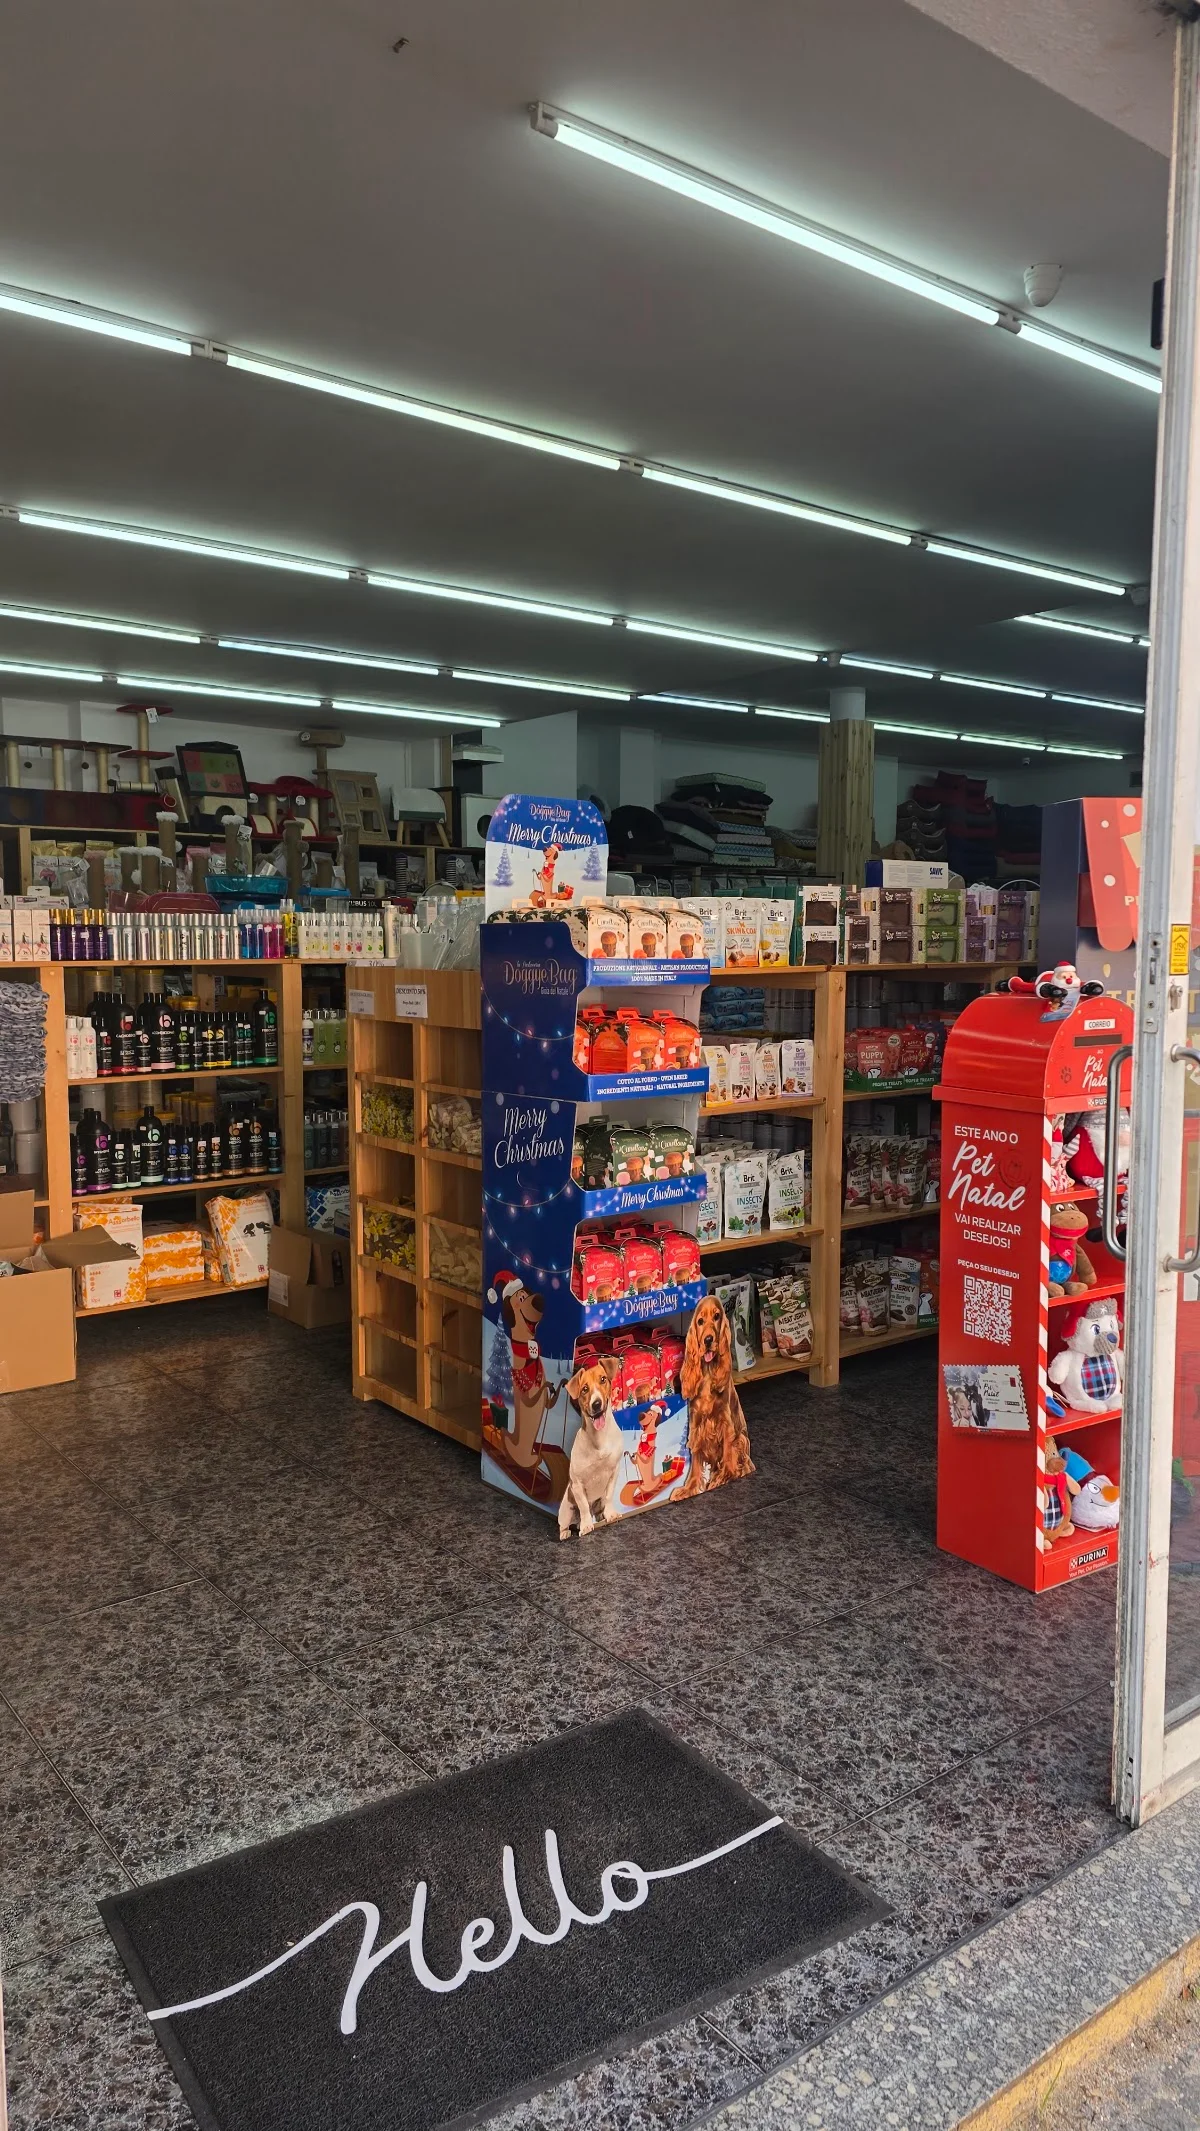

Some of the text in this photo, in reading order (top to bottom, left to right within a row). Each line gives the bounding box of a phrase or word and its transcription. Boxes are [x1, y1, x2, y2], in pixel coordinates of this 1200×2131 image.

[508, 822, 591, 848] Merry Christmas
[504, 958, 578, 995] Doggye Bag
[1088, 1020, 1111, 1028] CORREIO
[860, 1051, 884, 1060] PUPPY
[1084, 1054, 1104, 1073] Pet
[597, 1086, 630, 1095] INGREDIENTI
[1082, 1070, 1108, 1092] Nata
[503, 1107, 548, 1139] Merry
[954, 1125, 1019, 1144] ESTE ANO O
[494, 1133, 564, 1168] Christmas
[952, 1140, 996, 1177] Pet
[743, 1173, 755, 1182] Brit
[780, 1166, 794, 1175] Brit
[620, 1184, 684, 1209] Merry Christmas
[947, 1169, 1026, 1211] Natal
[699, 1200, 719, 1212] SECTS
[736, 1195, 763, 1205] INSECTS
[954, 1212, 1022, 1236] VAI REALIZAR
[963, 1229, 1011, 1249] DESEJOS!
[957, 1258, 974, 1269] PEÇA
[980, 1264, 993, 1273] SEU
[894, 1284, 916, 1293] JERKY
[622, 1290, 679, 1319] Doggye Bag
[778, 1310, 807, 1325] MEAT JERKY
[1078, 1548, 1107, 1565] PURINA
[147, 1816, 784, 2036] Hello
